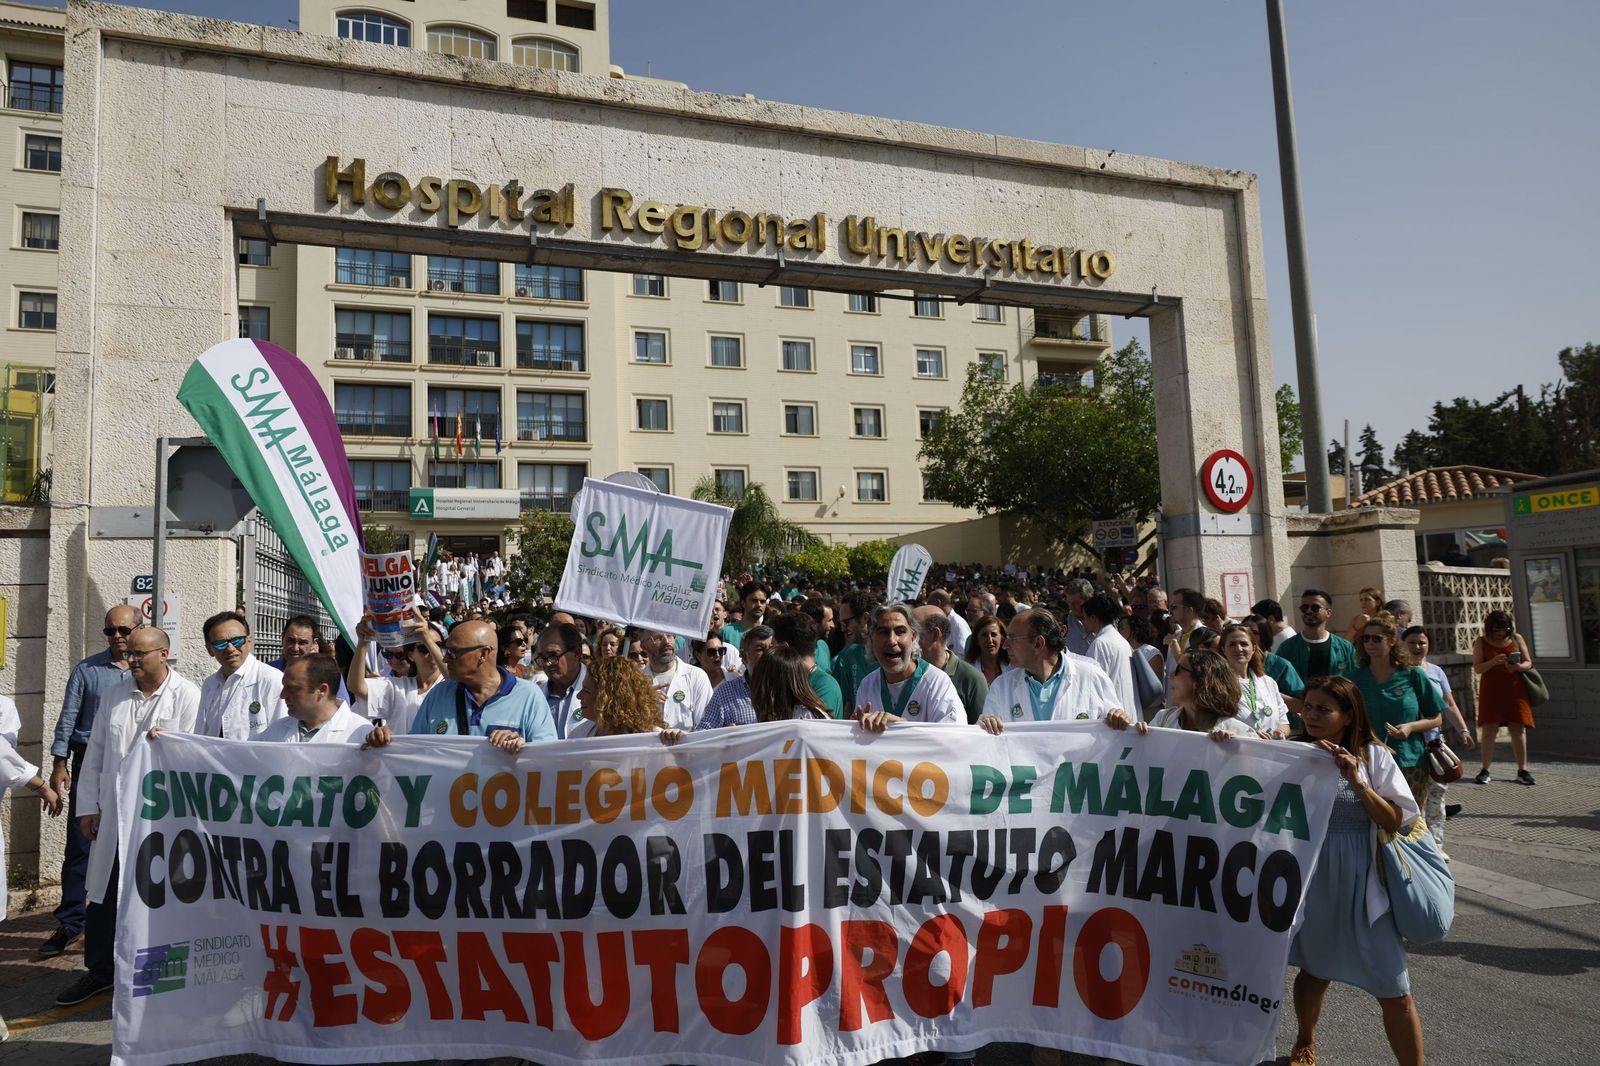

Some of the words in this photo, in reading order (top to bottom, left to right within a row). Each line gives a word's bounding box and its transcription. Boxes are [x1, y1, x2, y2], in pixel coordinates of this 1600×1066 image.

[326, 155, 575, 229] Hospital
[600, 187, 826, 251] Regional
[846, 215, 1116, 280] Universitario
[231, 367, 298, 450] SMA
[286, 443, 349, 550] Málaga
[1537, 490, 1592, 509] ONCE
[580, 511, 703, 577] SMA
[369, 575, 412, 593] JUNIO
[577, 564, 618, 581] Sindicato
[620, 572, 653, 590] Médico
[654, 580, 692, 597] Andaluz
[651, 590, 700, 611] Málaga
[140, 769, 381, 829] SINDICATO
[394, 774, 433, 828] Y
[449, 765, 695, 828] COLEGIO
[715, 739, 950, 818] MÉDICO
[969, 764, 1038, 815] DE
[1050, 747, 1311, 841] MÁLAGA
[135, 829, 302, 915] CONTRA
[311, 841, 364, 918] EL
[378, 834, 687, 920] BORRADOR
[703, 829, 805, 914] DEL
[823, 825, 1077, 909] ESTATUTO
[1086, 826, 1302, 933] MARCO
[194, 934, 251, 953] SINDICATO
[194, 950, 240, 969] MÉDICO
[194, 967, 244, 986] MÁLAGA
[260, 904, 1150, 1046] #ESTATUTOPROPIO
